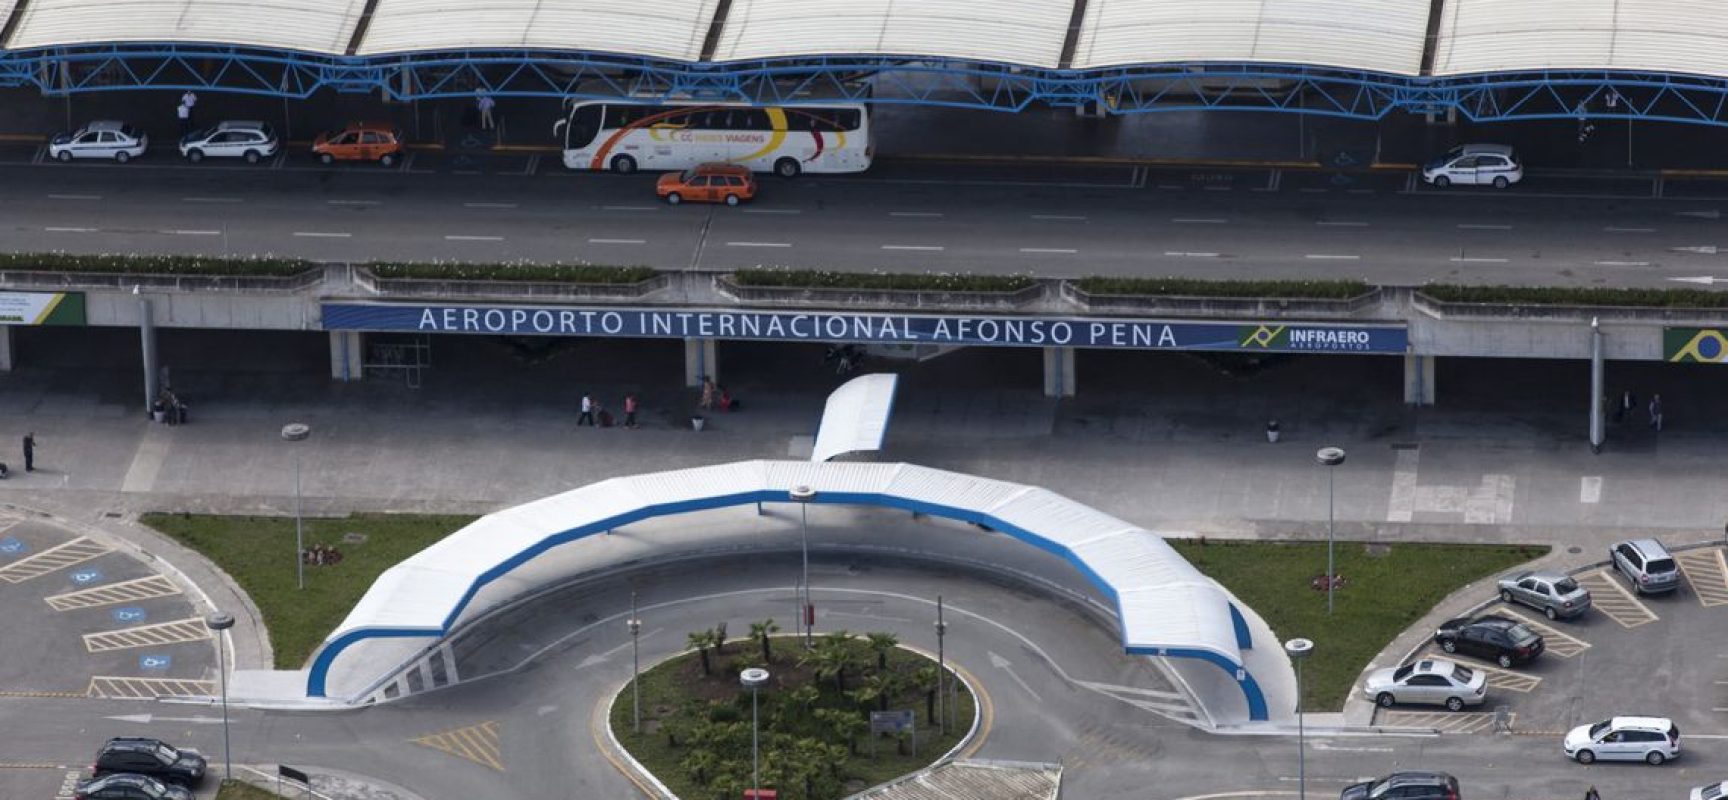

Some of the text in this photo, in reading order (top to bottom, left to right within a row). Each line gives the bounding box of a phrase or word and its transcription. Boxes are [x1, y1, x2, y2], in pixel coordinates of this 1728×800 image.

[419, 308, 1177, 346] AEROPORTO INTERNACIONAL AFONSO PENA
[1289, 329, 1370, 343] INFRAERO
